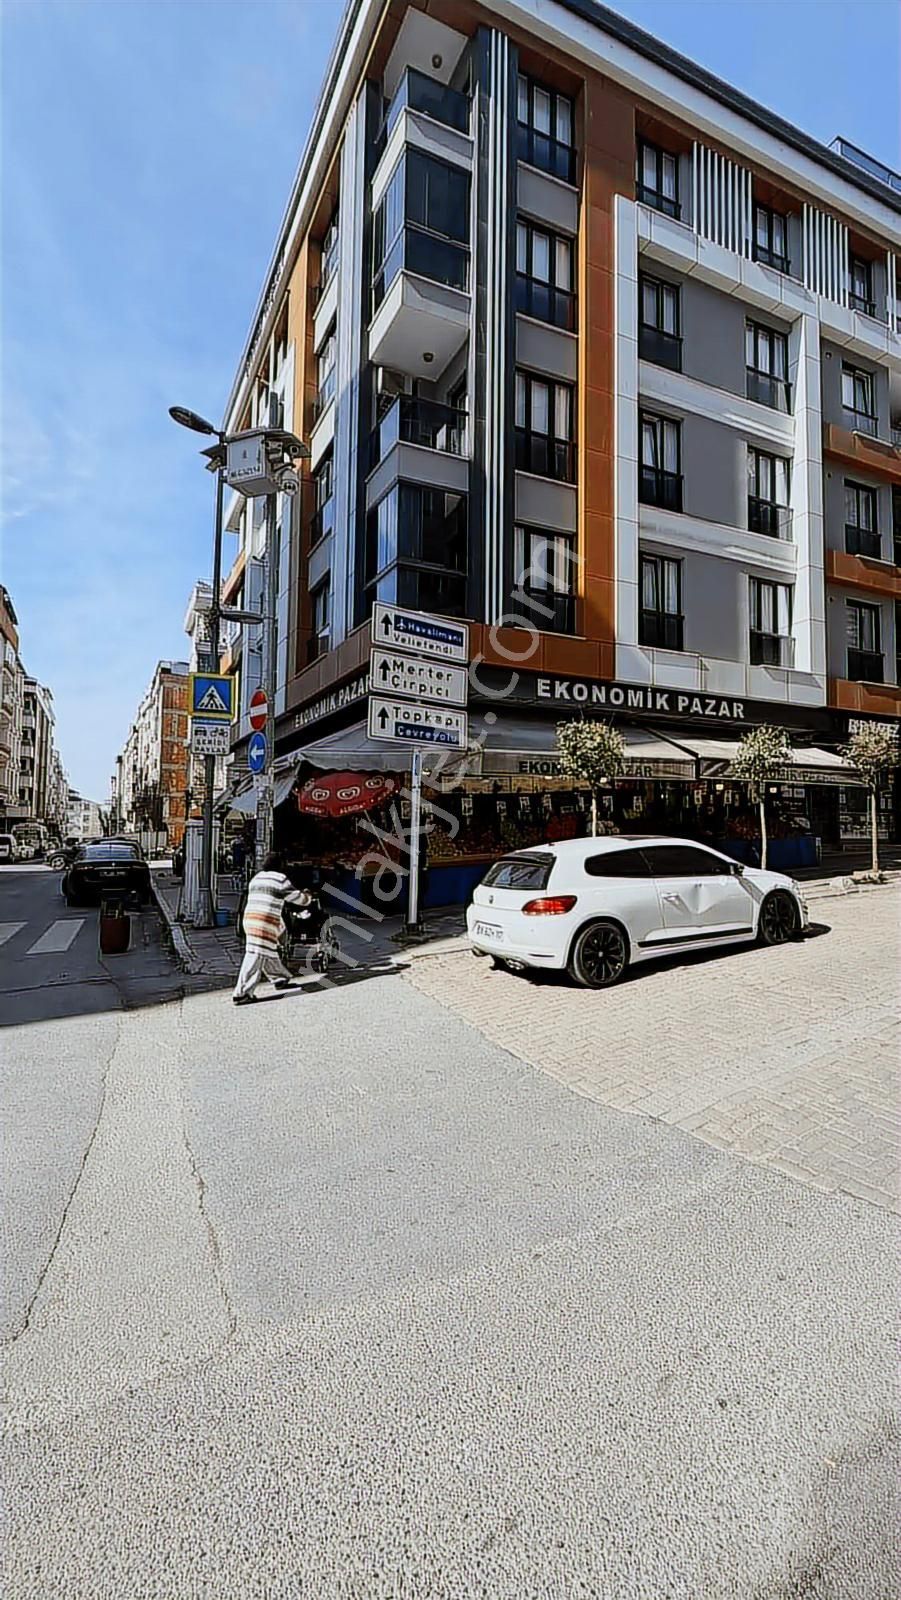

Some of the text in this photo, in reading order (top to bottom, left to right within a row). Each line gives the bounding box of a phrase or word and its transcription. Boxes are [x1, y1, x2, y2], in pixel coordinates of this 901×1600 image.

[392, 659, 452, 682] Merter
[391, 675, 449, 697] Çırpıcı
[537, 678, 745, 719] EKONOMİK PAZAR
[393, 706, 459, 727] Topkapı
[397, 725, 458, 743] Çevreyolu
[612, 765, 652, 777] AZAR
